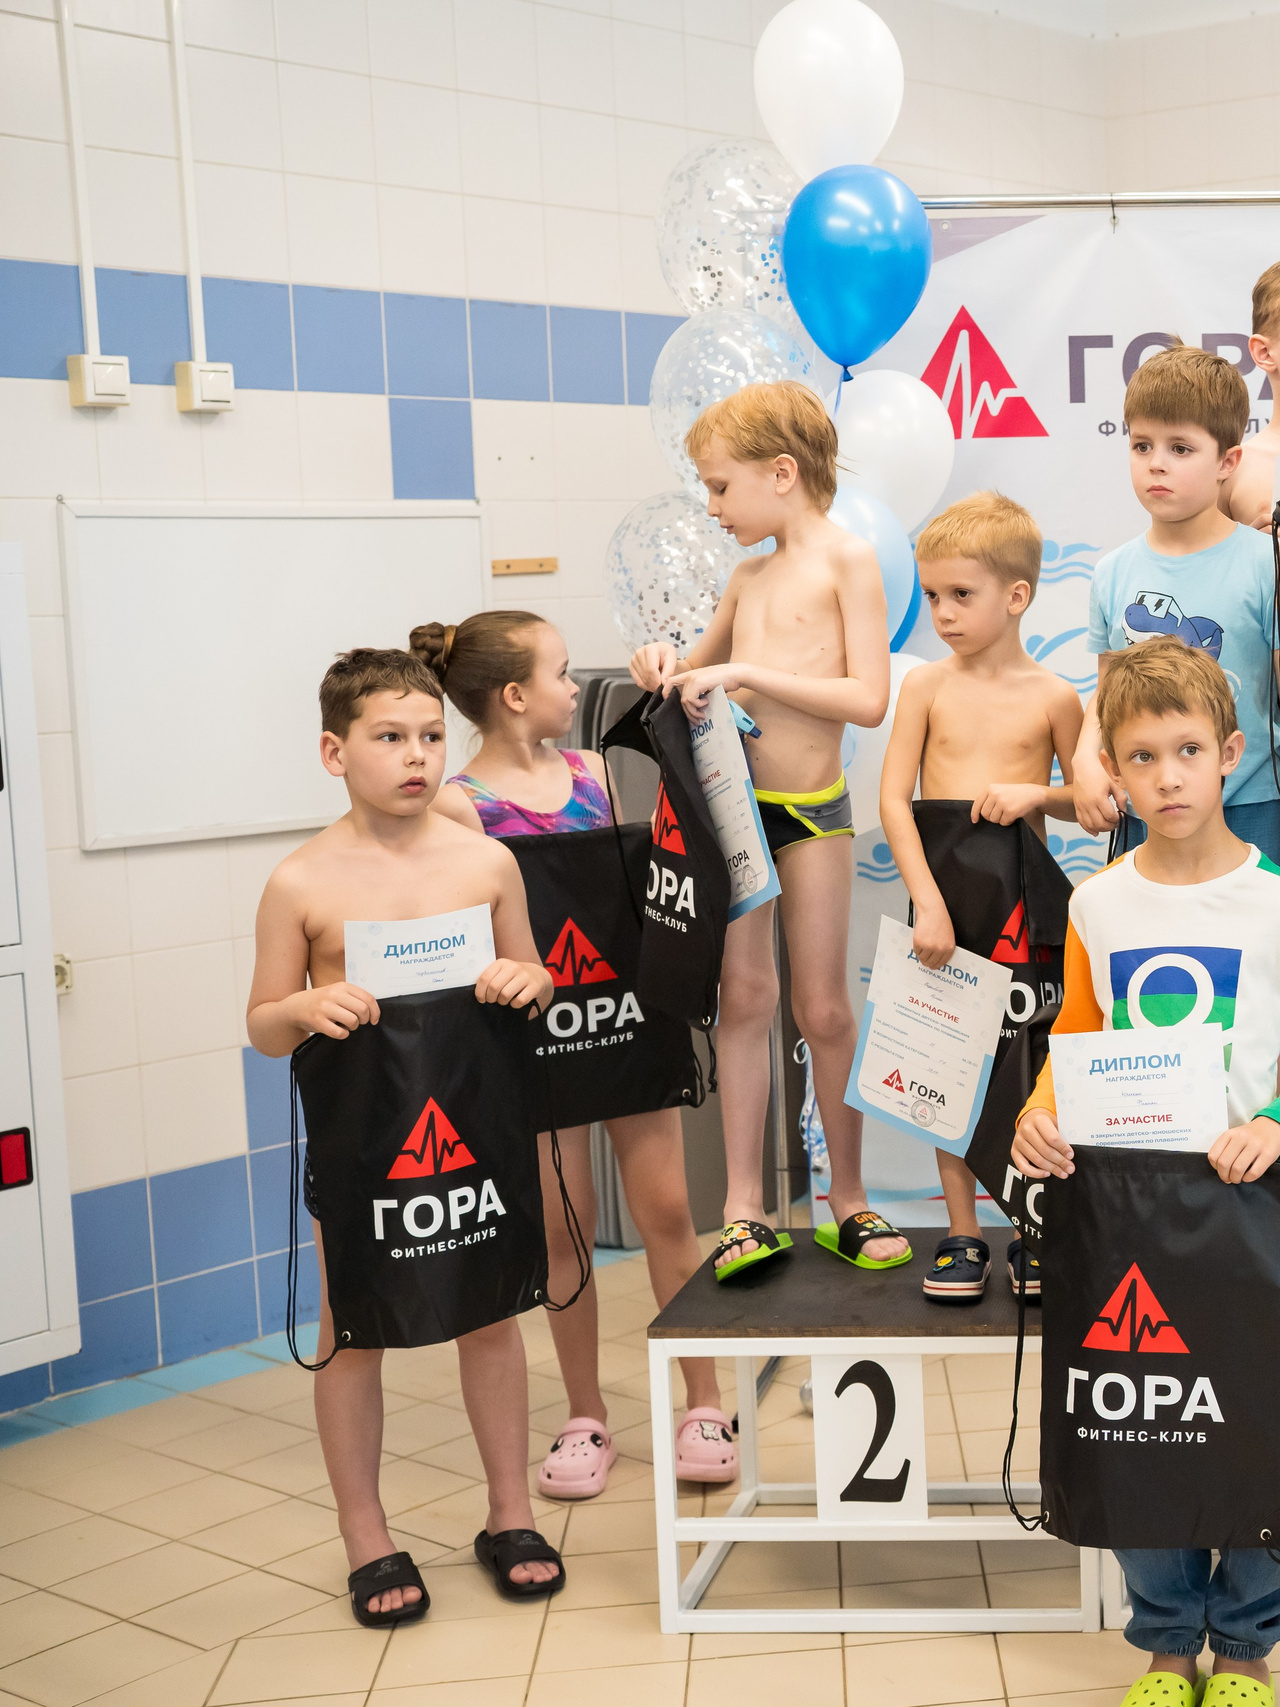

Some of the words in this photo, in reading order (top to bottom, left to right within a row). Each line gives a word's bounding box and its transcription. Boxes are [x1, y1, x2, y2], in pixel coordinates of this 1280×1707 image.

[727, 849, 750, 872] ГОРА
[647, 860, 696, 918] ОРА
[644, 905, 687, 933] ТНЕС-КЛУБ
[384, 934, 466, 958] ДИПЛОМ
[400, 952, 455, 965] НАГРАЖДАЕТСЯ
[918, 966, 964, 990] НАГРАЖДАЕТСЯ
[547, 992, 645, 1038] ОРА
[908, 995, 920, 1006] ЗА
[921, 1002, 960, 1024] УЧАСТИЕ
[1089, 1053, 1181, 1075] ДИПЛОМ
[1105, 1073, 1166, 1083] НАГРАЖДАЕТСЯ
[909, 1080, 946, 1106] ГОРА
[1105, 1117, 1120, 1126] ЗА
[1122, 1114, 1173, 1125] УЧАСТИЕ
[373, 1178, 507, 1240] ГОРА
[391, 1227, 497, 1259] ФИТНЕС-КЛУБ
[1066, 1367, 1225, 1423] ГОРА
[835, 1360, 911, 1503] 2
[1077, 1426, 1207, 1444] ФИТНЕС-КЛУБ
